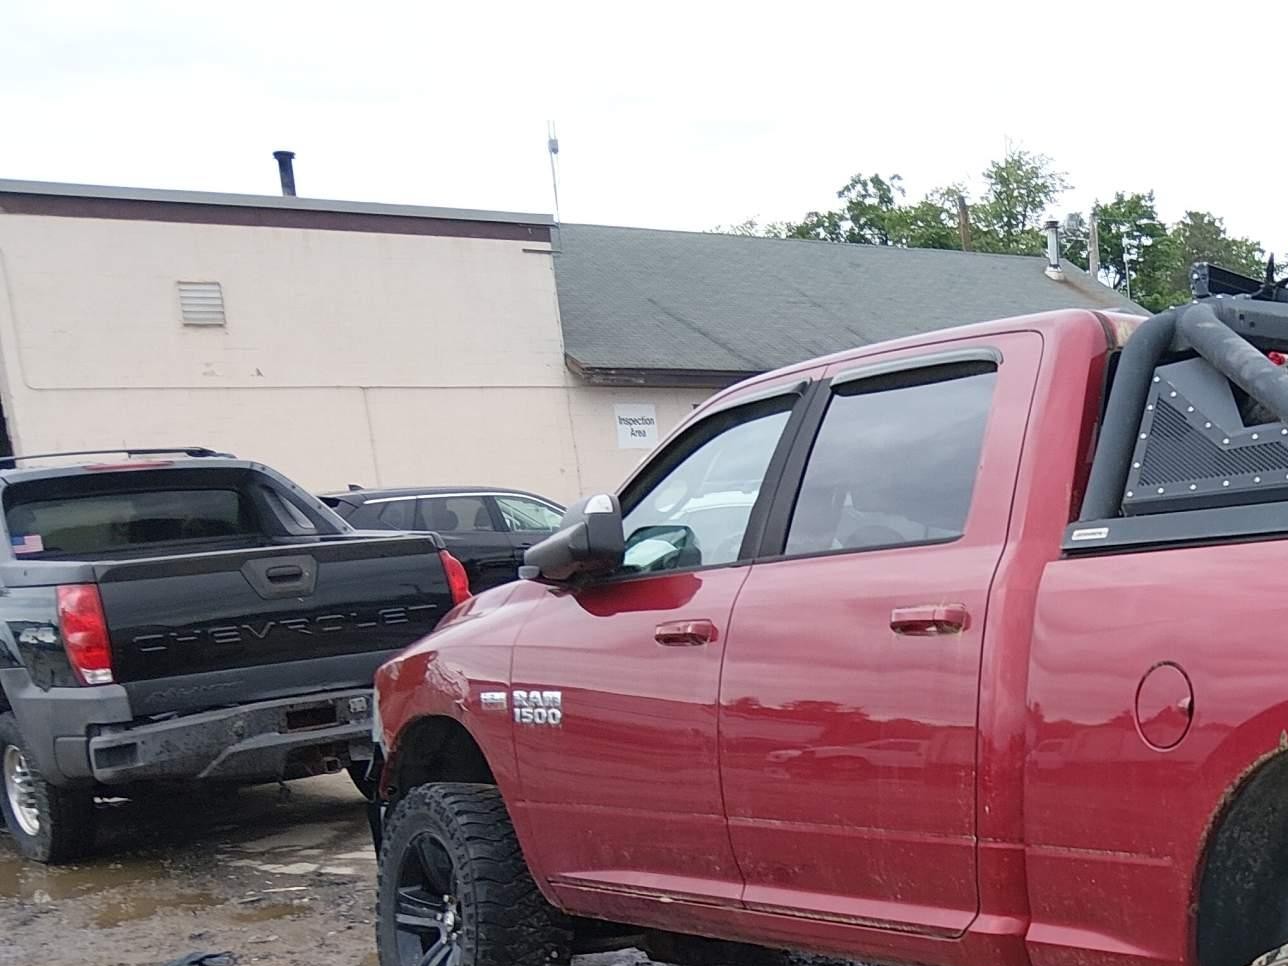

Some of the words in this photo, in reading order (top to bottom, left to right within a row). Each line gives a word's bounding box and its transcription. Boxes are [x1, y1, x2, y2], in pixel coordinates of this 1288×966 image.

[617, 415, 655, 426] Inspection
[630, 428, 647, 438] Area
[131, 603, 438, 652] CHEVROLET
[512, 690, 562, 707] RAM
[513, 707, 562, 725] 1500
